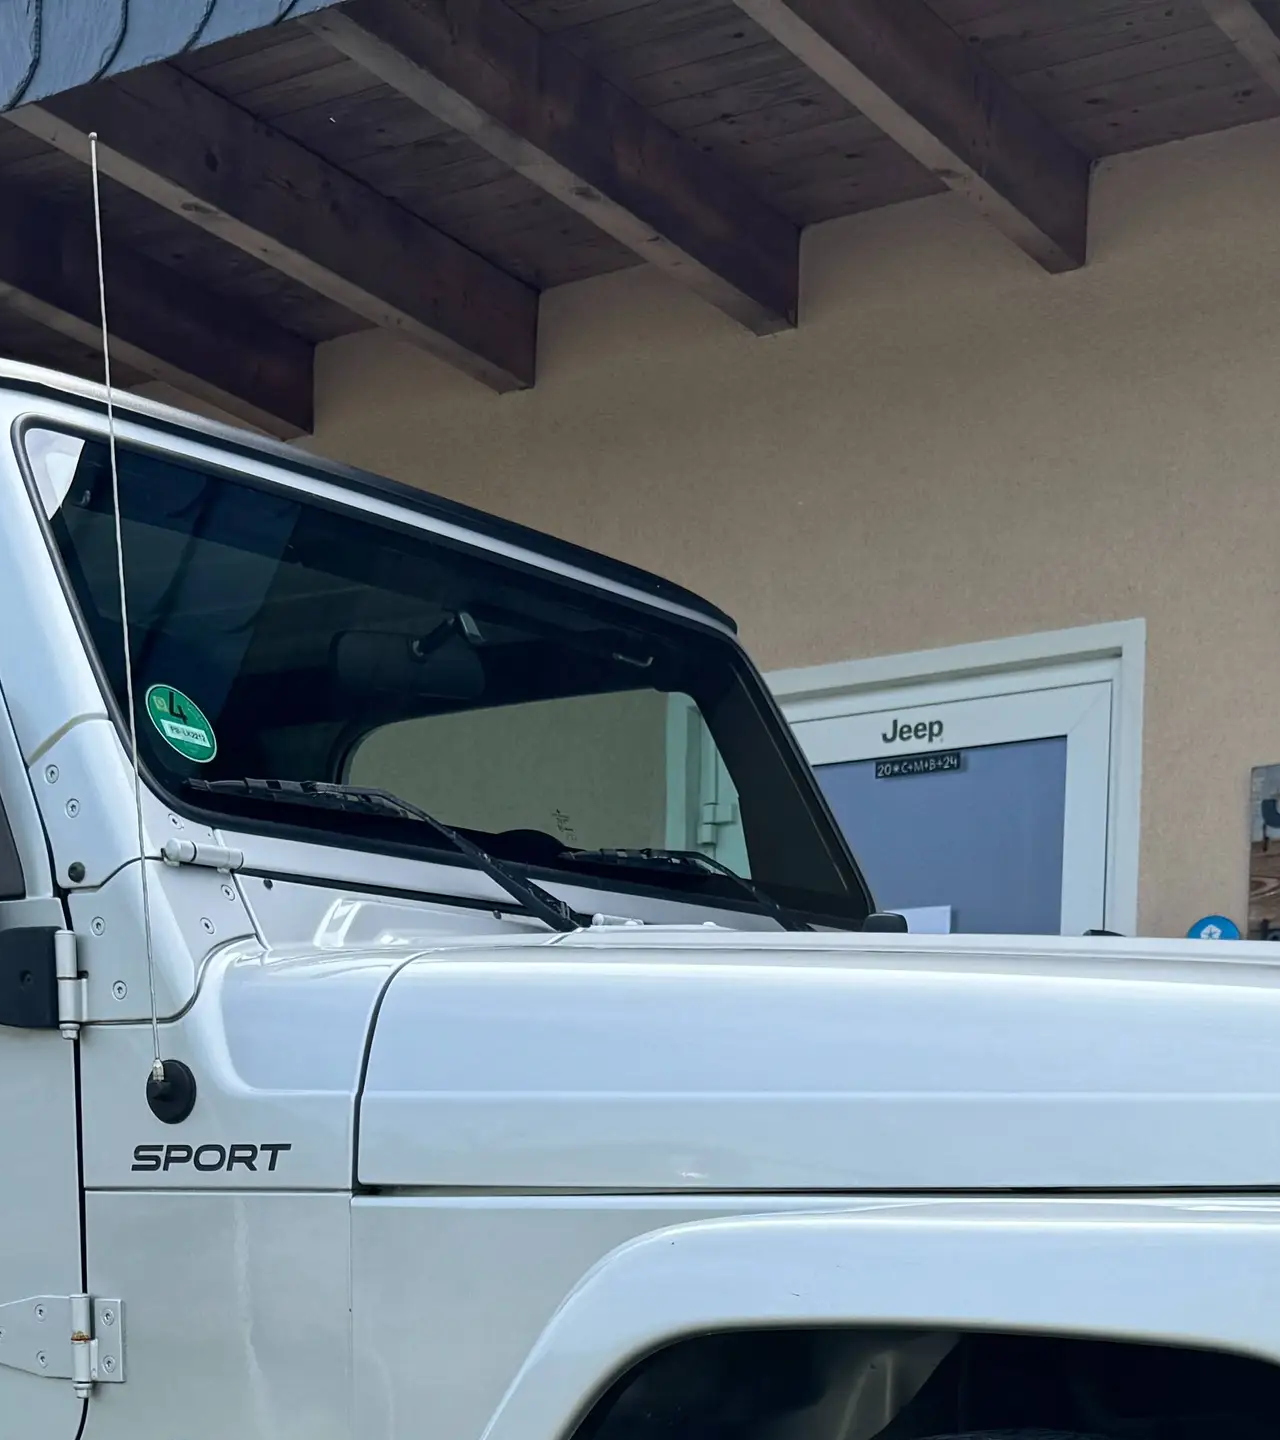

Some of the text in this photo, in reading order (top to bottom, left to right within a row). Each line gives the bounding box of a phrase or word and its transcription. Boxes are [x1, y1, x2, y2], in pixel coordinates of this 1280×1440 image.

[169, 691, 188, 725] 4
[881, 719, 944, 744] Jeep
[131, 1143, 292, 1172] SPORT
